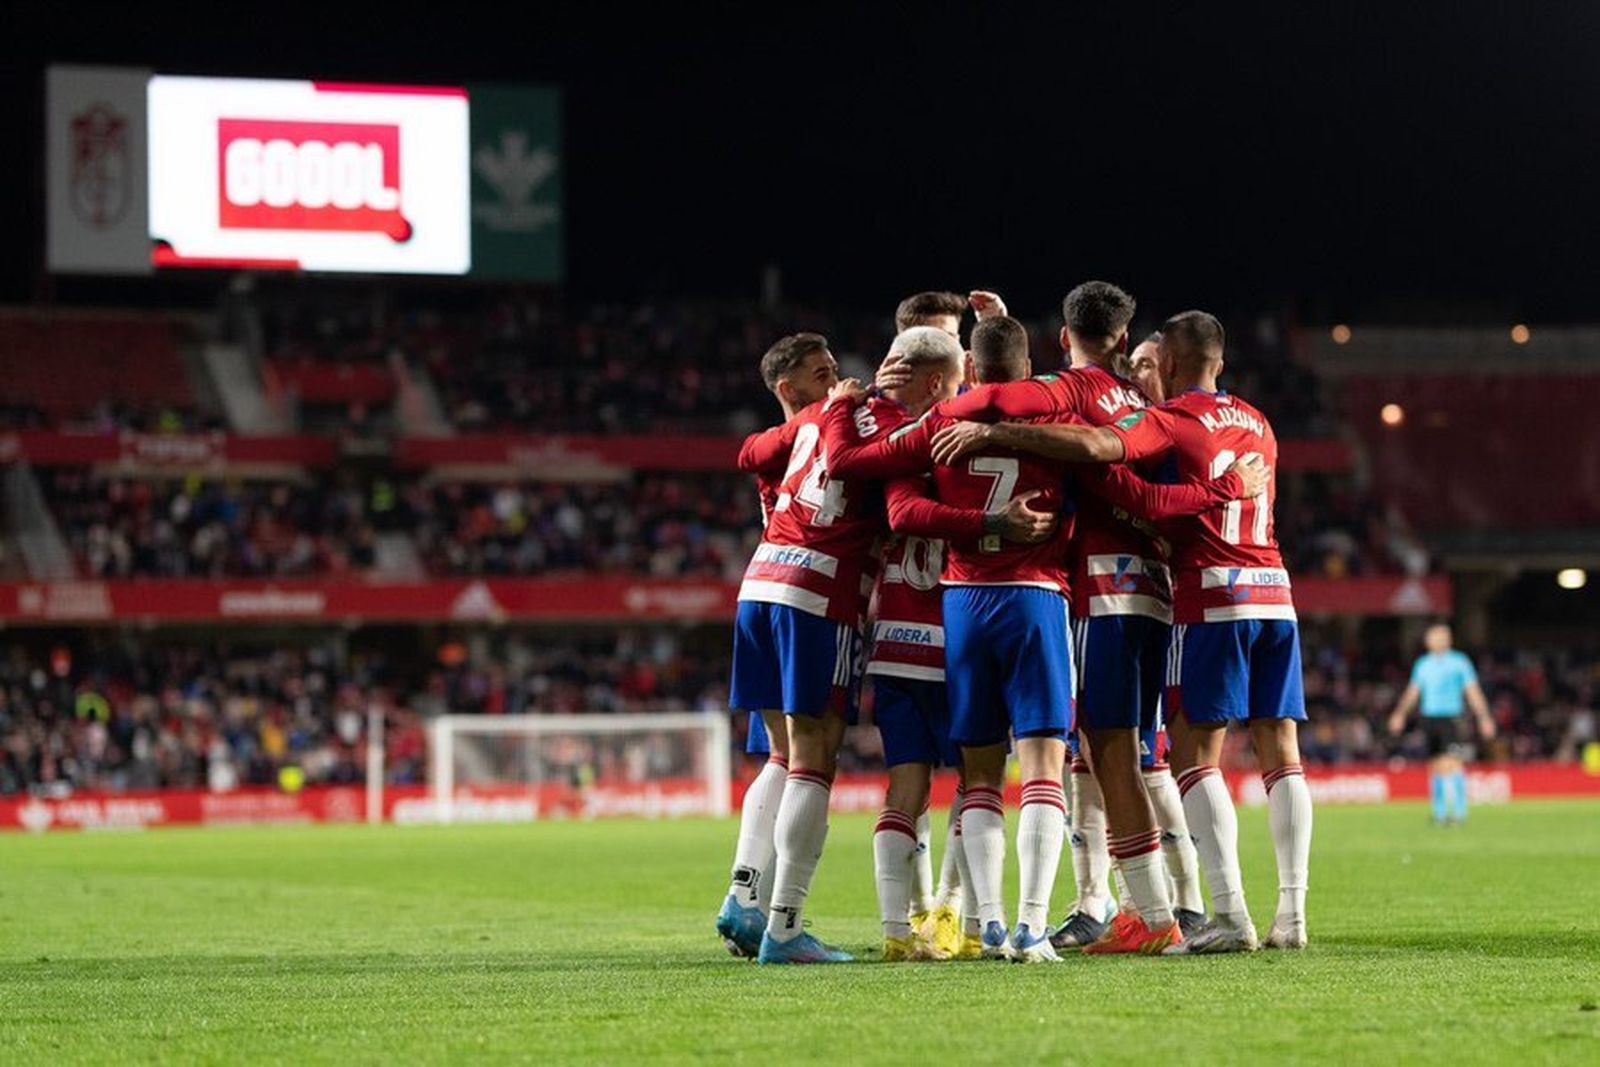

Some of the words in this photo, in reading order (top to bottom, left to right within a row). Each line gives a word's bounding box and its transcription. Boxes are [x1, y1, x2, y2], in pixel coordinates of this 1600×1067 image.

[226, 138, 398, 211] GOOOL
[774, 423, 848, 527] 24
[968, 456, 1020, 553] 7
[1208, 449, 1271, 547] 11
[882, 536, 944, 591] 0
[884, 626, 932, 644] LIDERA
